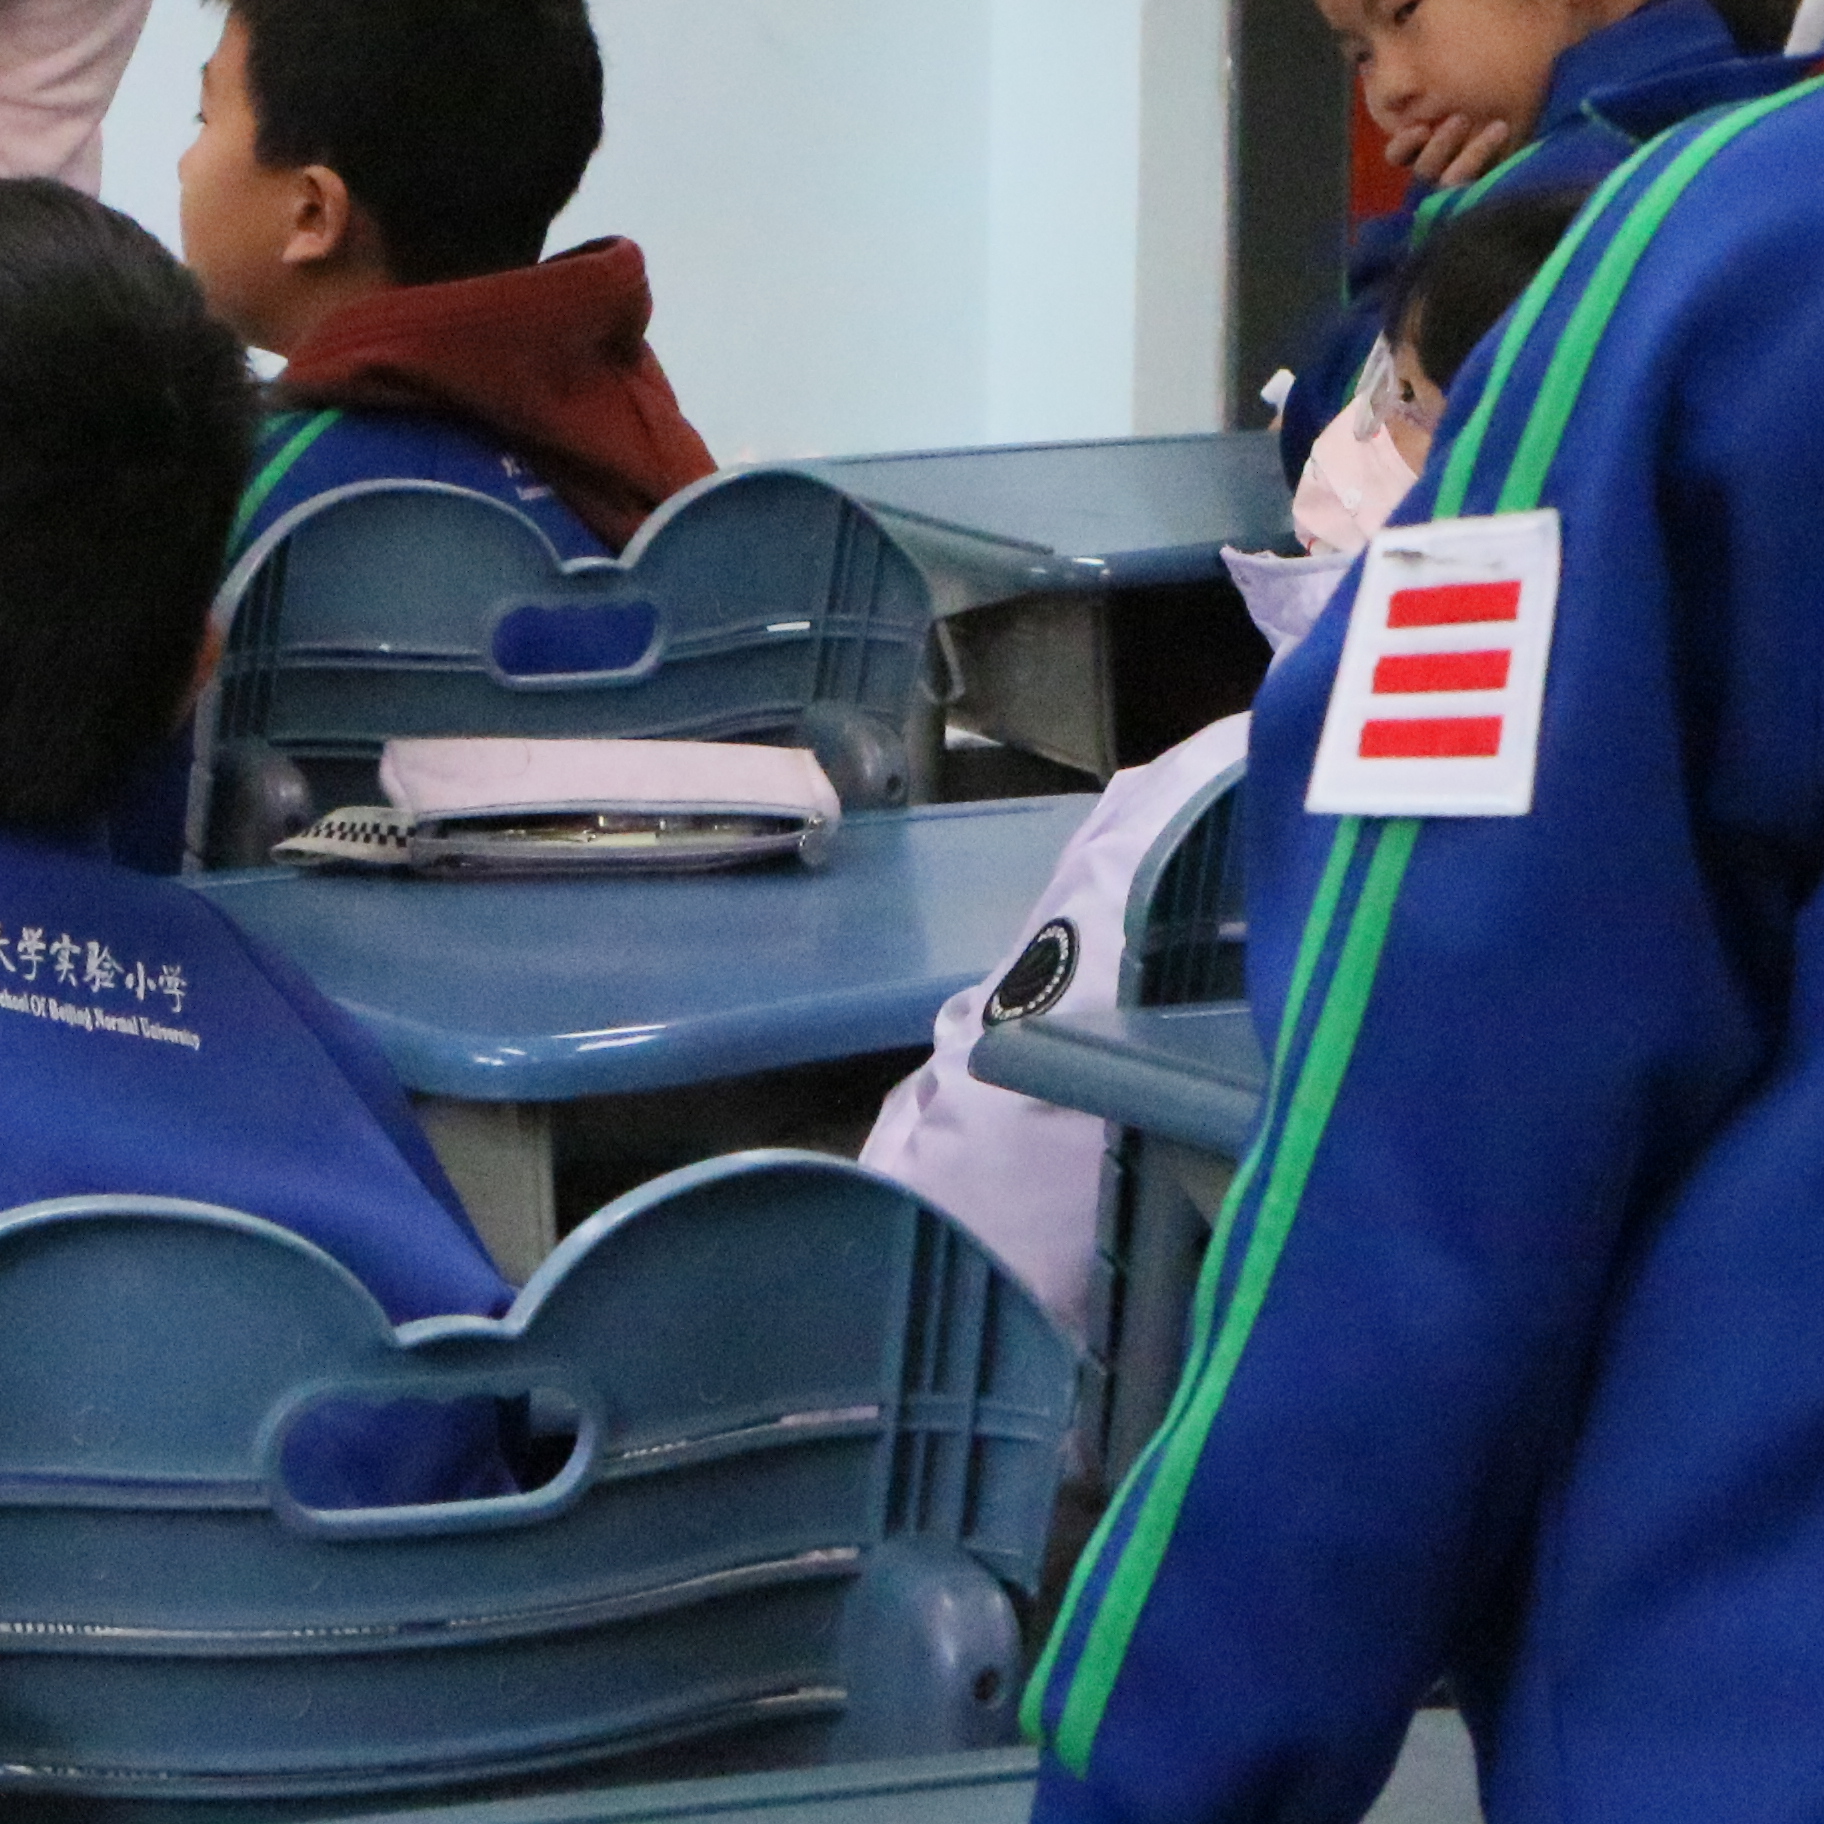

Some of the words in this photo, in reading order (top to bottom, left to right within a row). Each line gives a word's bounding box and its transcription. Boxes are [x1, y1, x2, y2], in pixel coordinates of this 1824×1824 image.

[48, 997, 93, 1031] Beijing
[93, 1007, 140, 1036] Normal
[138, 1016, 200, 1051] University
